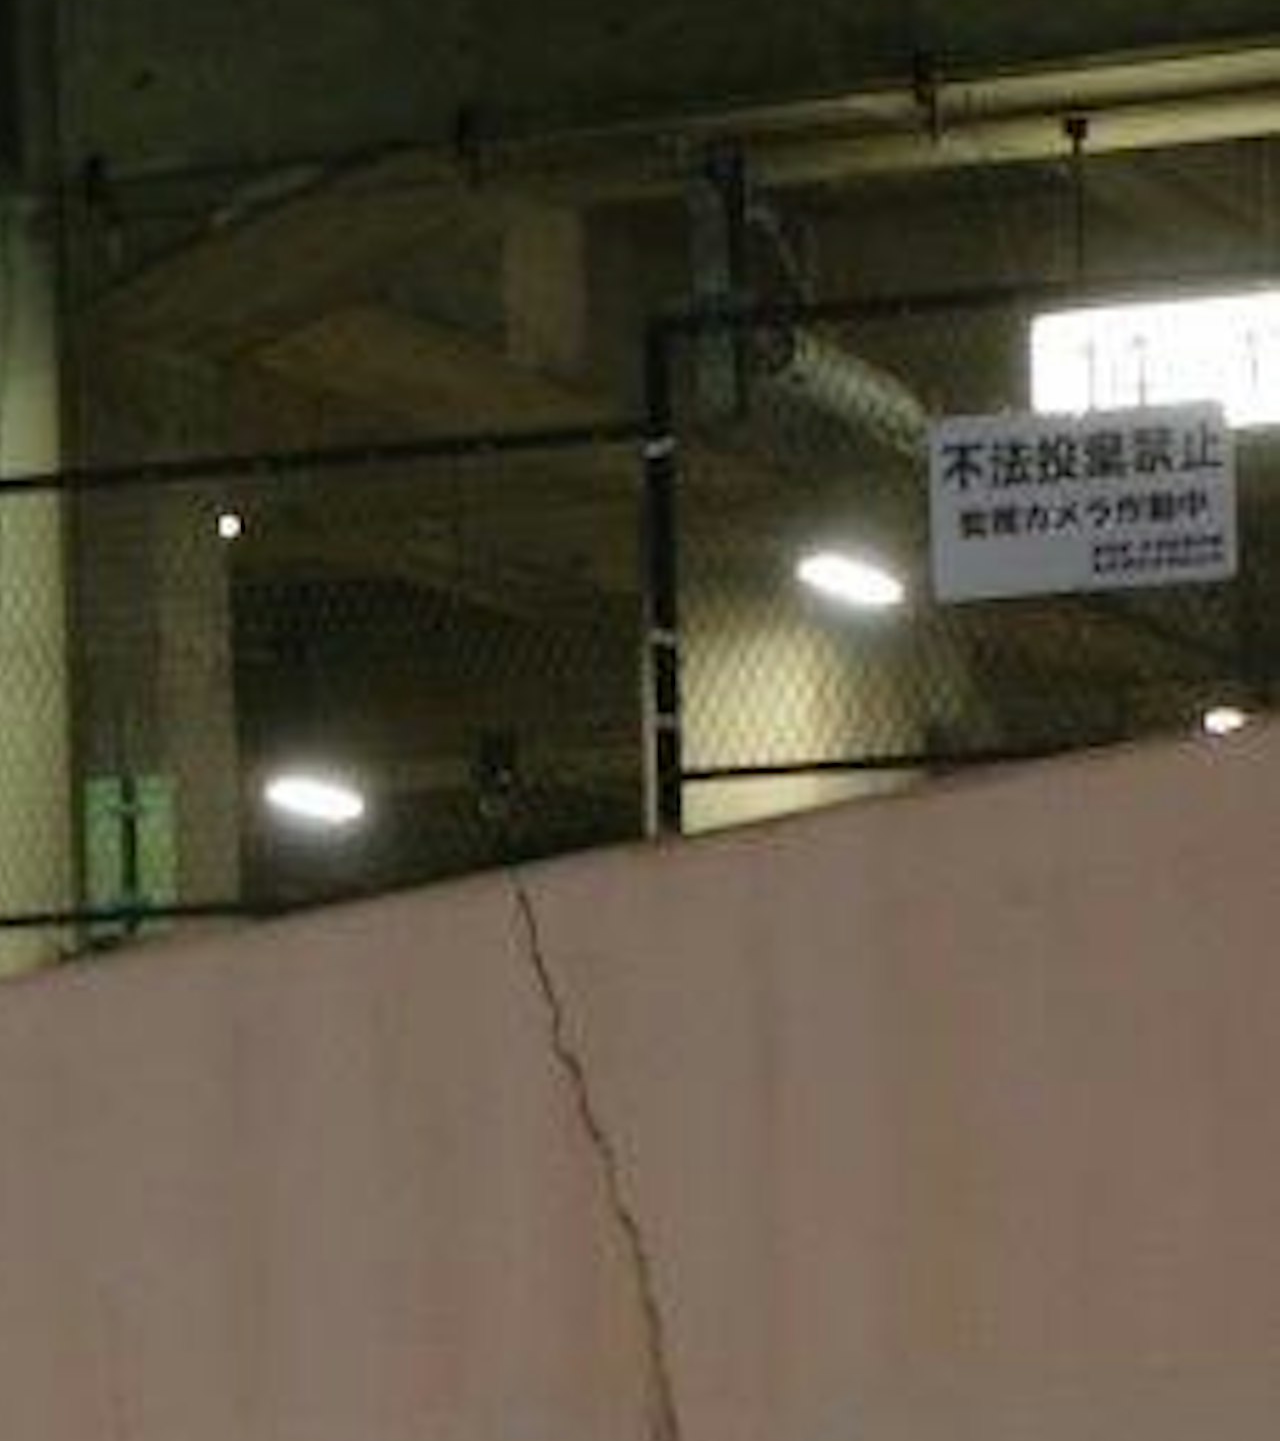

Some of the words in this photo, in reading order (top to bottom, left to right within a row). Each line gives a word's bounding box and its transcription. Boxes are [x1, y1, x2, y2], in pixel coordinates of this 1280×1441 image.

[942, 423, 1224, 488] 不法投棄禁止
